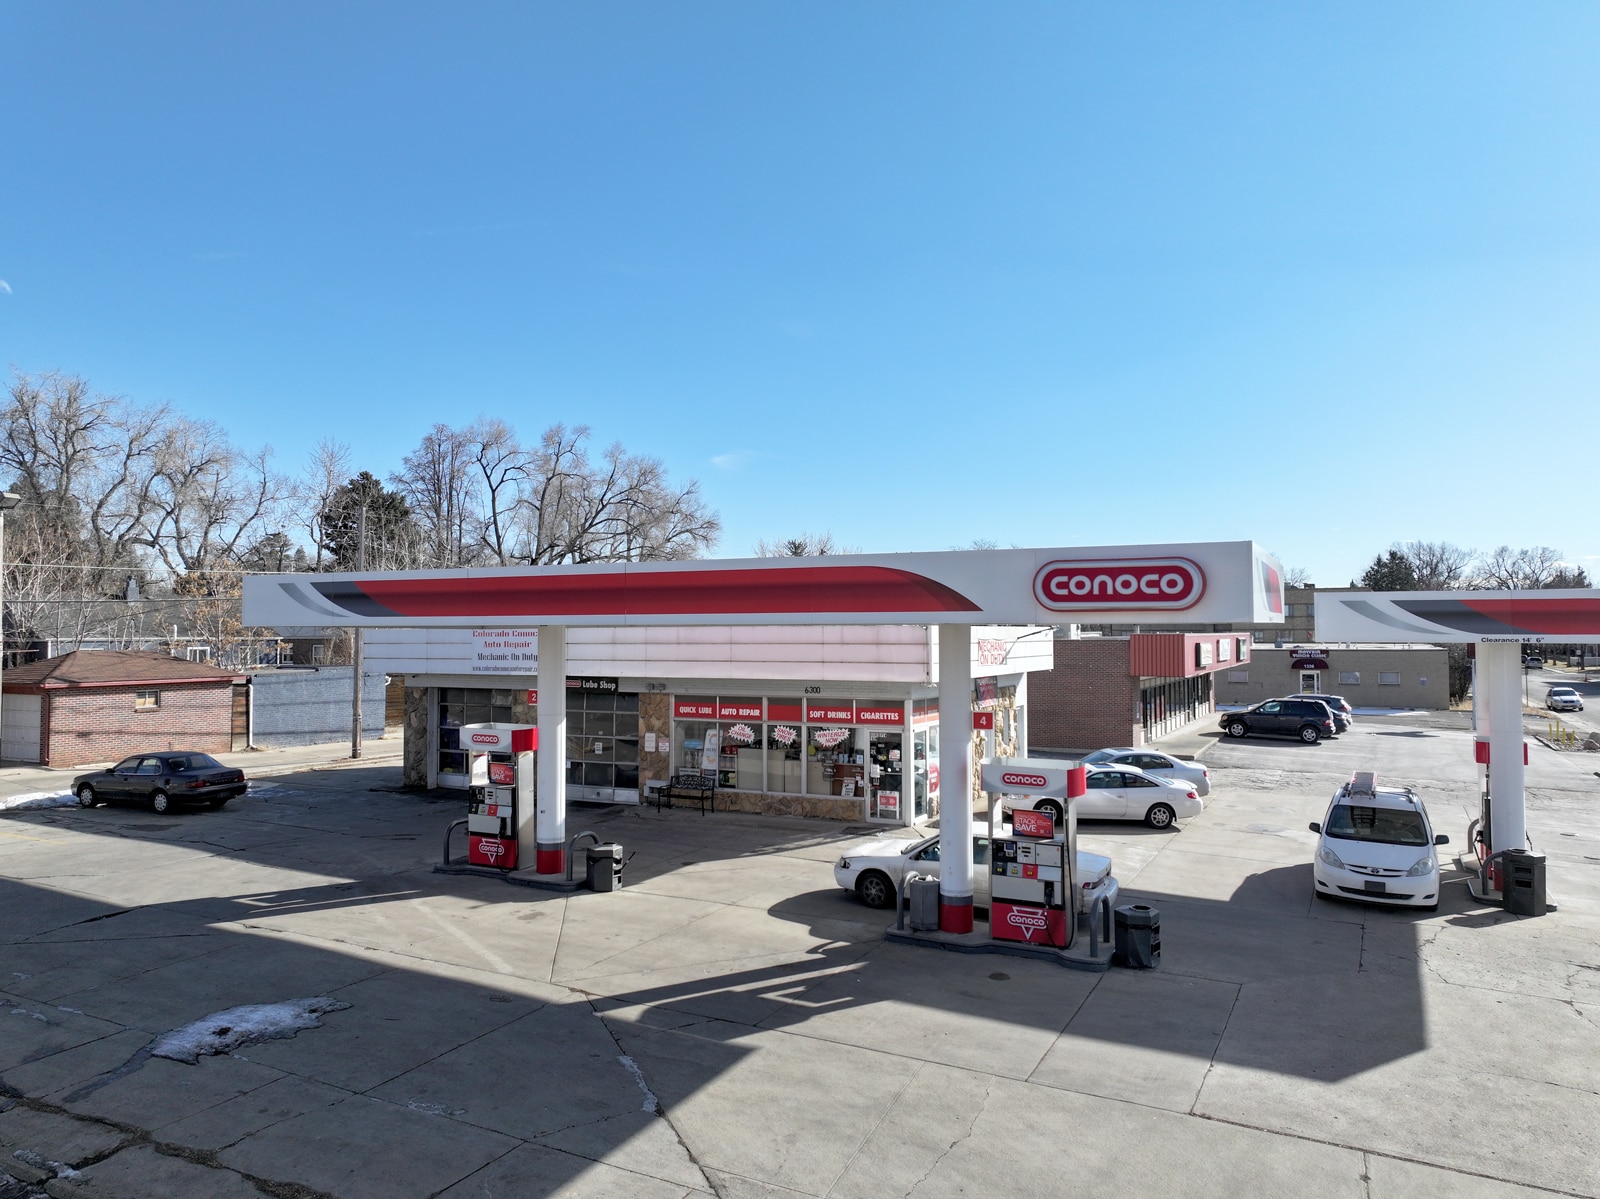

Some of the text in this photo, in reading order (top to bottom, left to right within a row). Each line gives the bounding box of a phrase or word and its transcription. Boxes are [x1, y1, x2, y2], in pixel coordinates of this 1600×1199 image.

[1050, 573, 1185, 596] conoco
[504, 640, 532, 649] Repair
[978, 640, 1007, 652] MECHANIC
[477, 653, 538, 662] Mechanic On Duty
[980, 654, 989, 665] ON
[582, 680, 616, 691] Lube Shop
[804, 686, 821, 694] 6300
[531, 693, 537, 701] 2
[679, 706, 712, 714] QUICK LUBE
[827, 711, 851, 719] DRINKS
[860, 712, 899, 720] CIGARETTES
[980, 716, 987, 725] 4
[731, 730, 752, 739] CHANGE
[776, 728, 794, 736] SNOW
[472, 735, 498, 743] conoco
[775, 733, 792, 741] TIRES
[1003, 774, 1044, 786] conoco
[1015, 824, 1037, 832] SAVE
[1010, 915, 1045, 926] conoco
